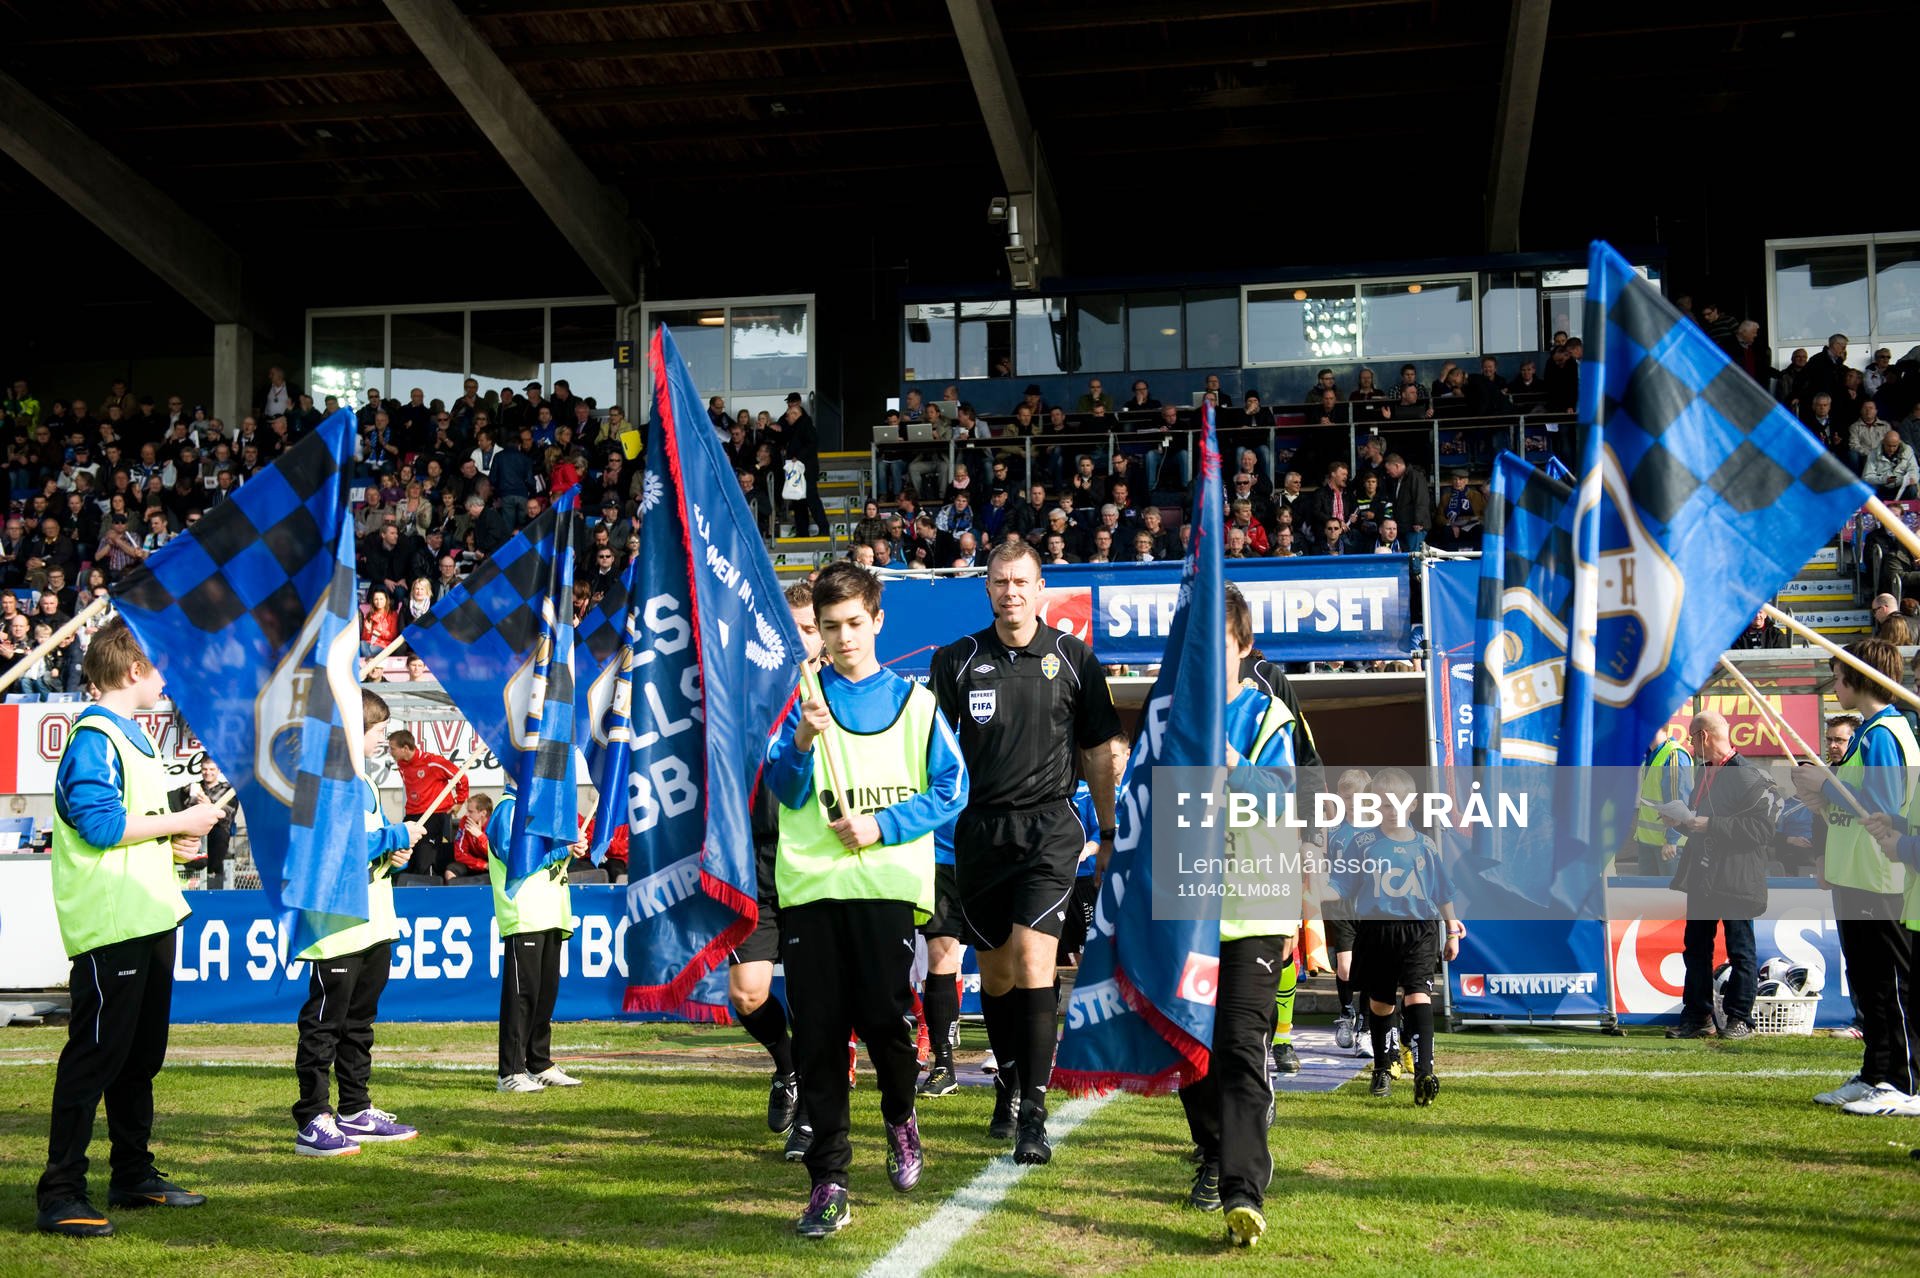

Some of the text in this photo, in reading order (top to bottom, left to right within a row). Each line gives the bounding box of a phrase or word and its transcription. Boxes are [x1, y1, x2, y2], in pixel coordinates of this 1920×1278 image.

[619, 346, 630, 363] E
[1108, 587, 1389, 637] STRTIPSET
[972, 703, 992, 711] FIFA
[858, 786, 918, 807] INTE
[1373, 868, 1426, 899] ICA
[1489, 974, 1594, 994] STRYKTIPSET
